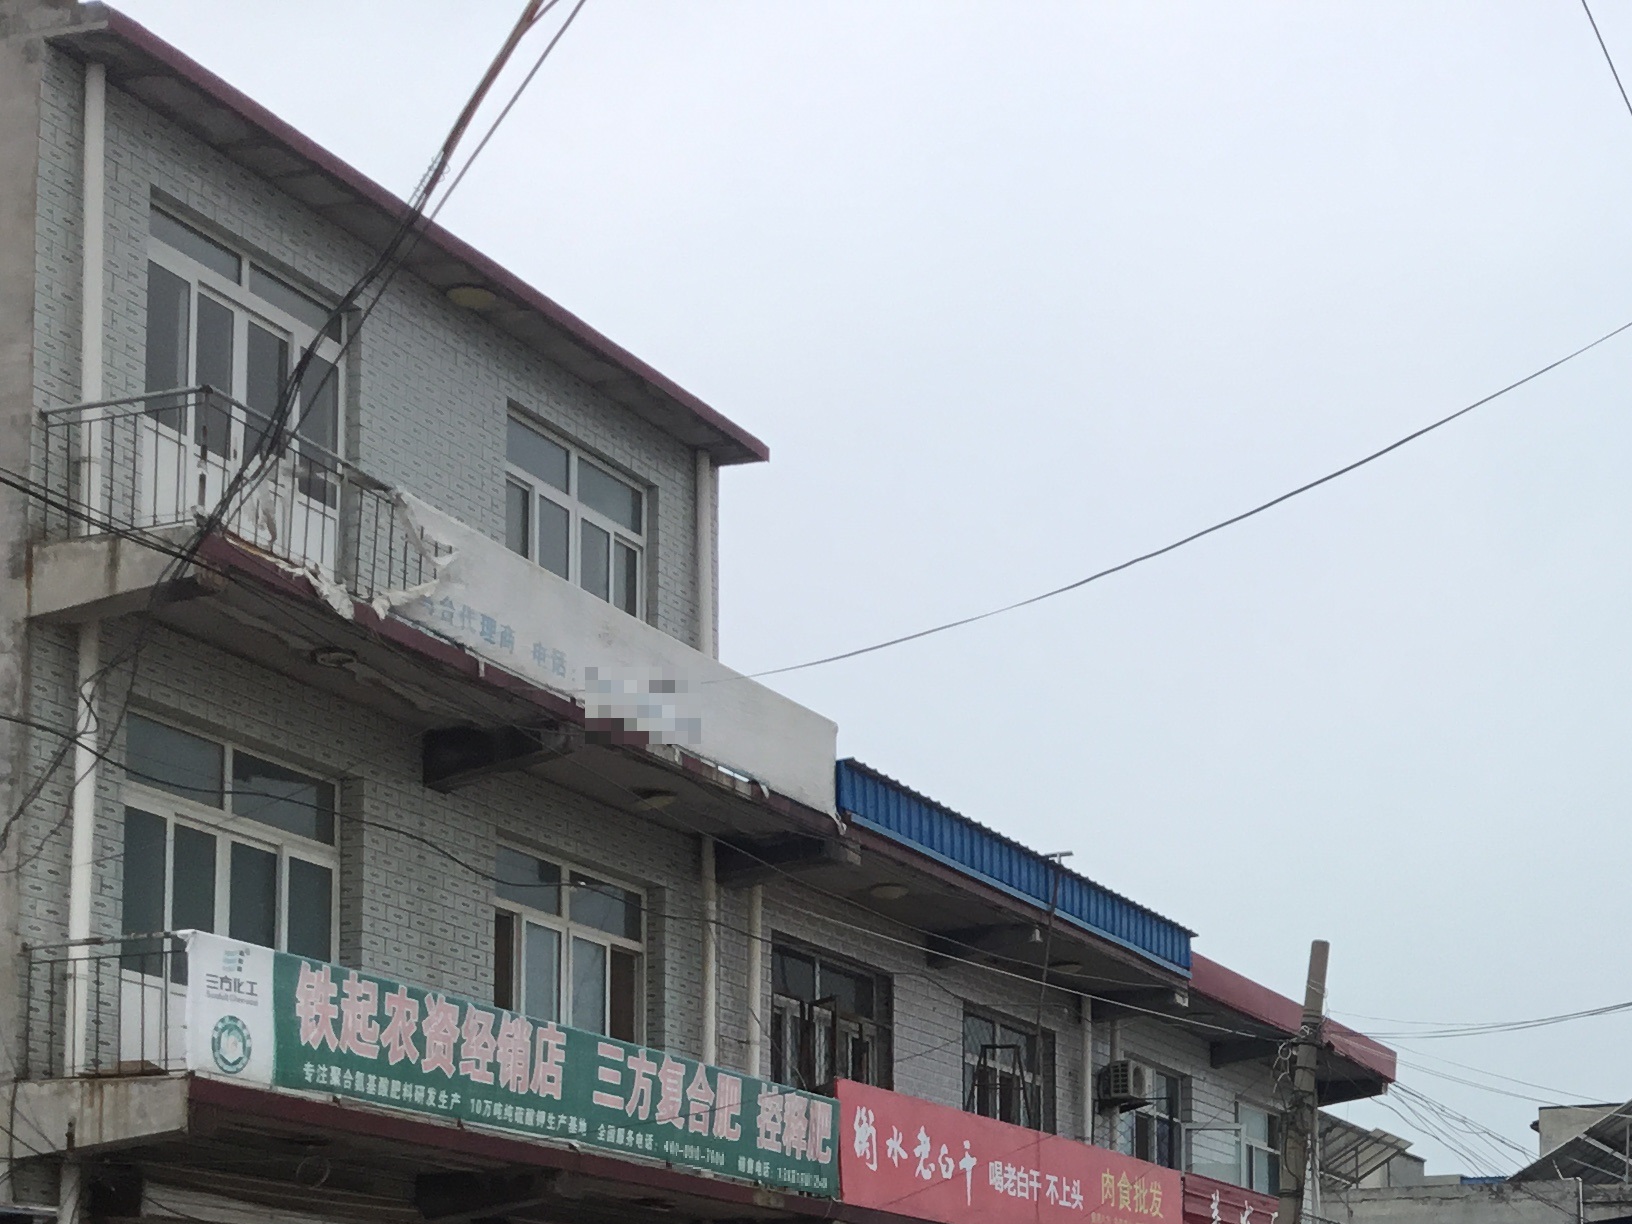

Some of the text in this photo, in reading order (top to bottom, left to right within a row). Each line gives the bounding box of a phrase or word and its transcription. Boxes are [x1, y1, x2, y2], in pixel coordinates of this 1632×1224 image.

[206, 974, 258, 997] 三方化工
[296, 960, 567, 1100] 铁起农资经销店
[593, 1042, 743, 1141] 三方复合肥
[853, 1106, 977, 1206] 衡水老白干
[1101, 1168, 1164, 1218] 肉食批发
